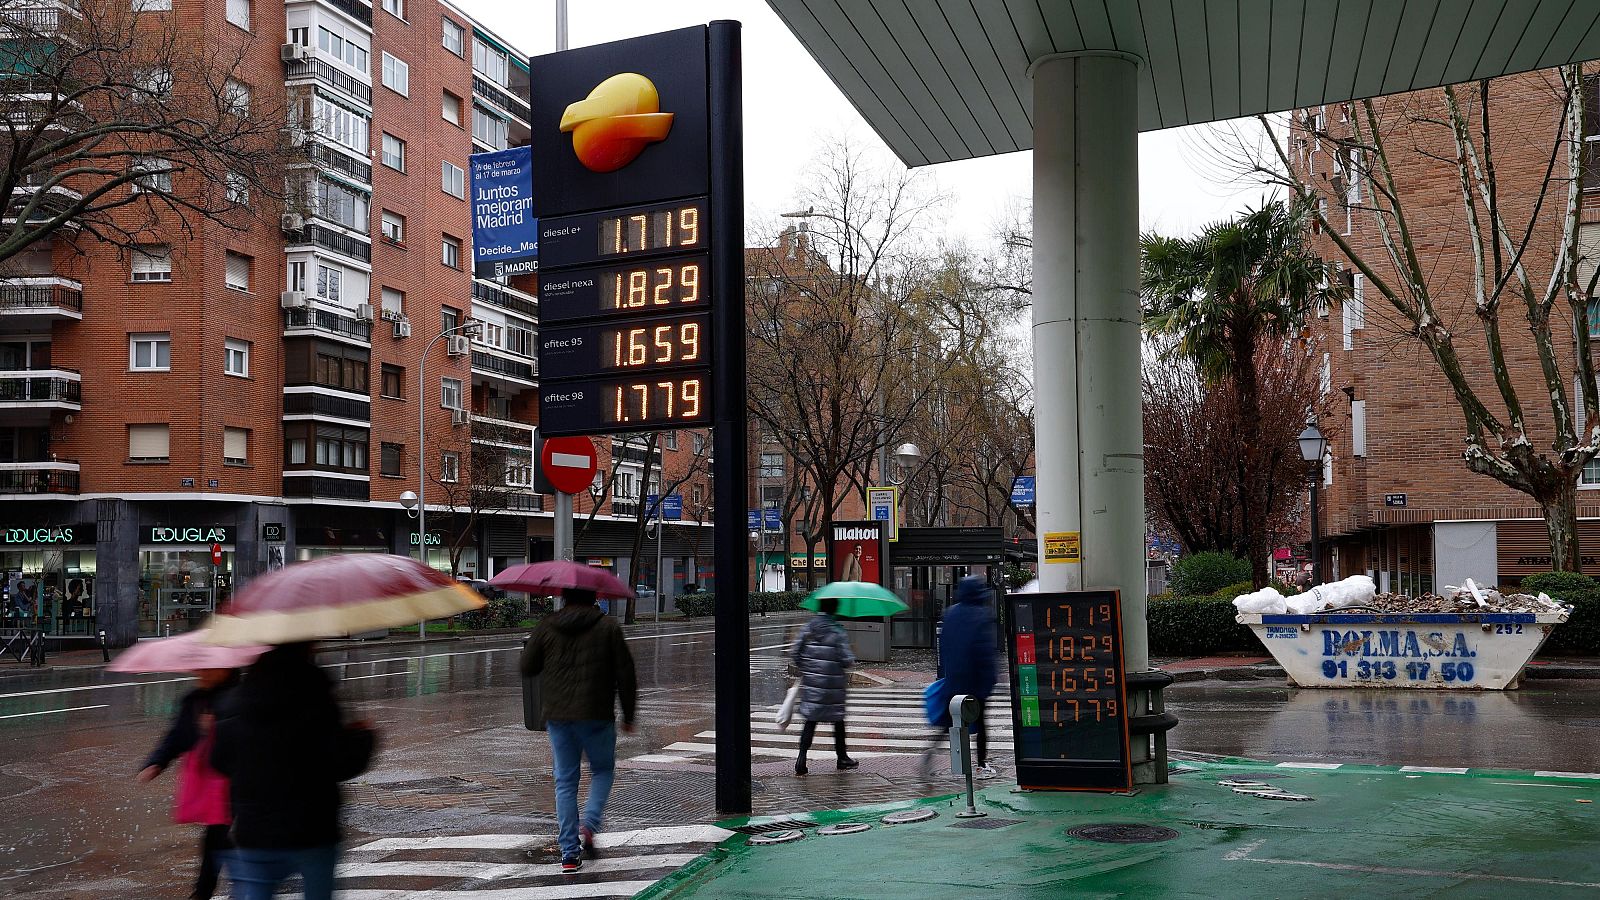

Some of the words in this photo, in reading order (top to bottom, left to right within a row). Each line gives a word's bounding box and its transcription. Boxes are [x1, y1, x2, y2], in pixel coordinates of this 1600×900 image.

[483, 162, 491, 170] de
[493, 160, 516, 169] febrero
[491, 170, 500, 178] de
[501, 168, 521, 176] marzo
[476, 184, 519, 201] Juntos
[477, 210, 523, 229] Madrid
[543, 228, 570, 238] diesel
[571, 226, 582, 235] e+
[615, 207, 698, 254] 1.719
[505, 260, 539, 273] MADRID
[543, 281, 570, 291] diesel
[571, 279, 594, 288] nexa
[615, 265, 699, 309] 1.829
[544, 339, 569, 349] efitec
[570, 337, 583, 346] 95
[615, 322, 698, 367] 1.659
[544, 393, 570, 402] efitec
[571, 391, 584, 400] 98
[616, 379, 700, 422] 1.779
[5, 528, 73, 543] DOUGLAS
[152, 527, 226, 542] DOUGLAS
[410, 532, 441, 545] DOGLAS
[833, 527, 879, 541] Mahou
[1046, 604, 1111, 633] 1.719
[1048, 635, 1113, 664] 1.829
[1321, 659, 1348, 679] 91
[1357, 660, 1397, 680] 313
[1405, 662, 1431, 681] 17
[1440, 661, 1475, 682] 50
[1051, 667, 1115, 696] 1.659
[1053, 699, 1118, 727] 1.779
